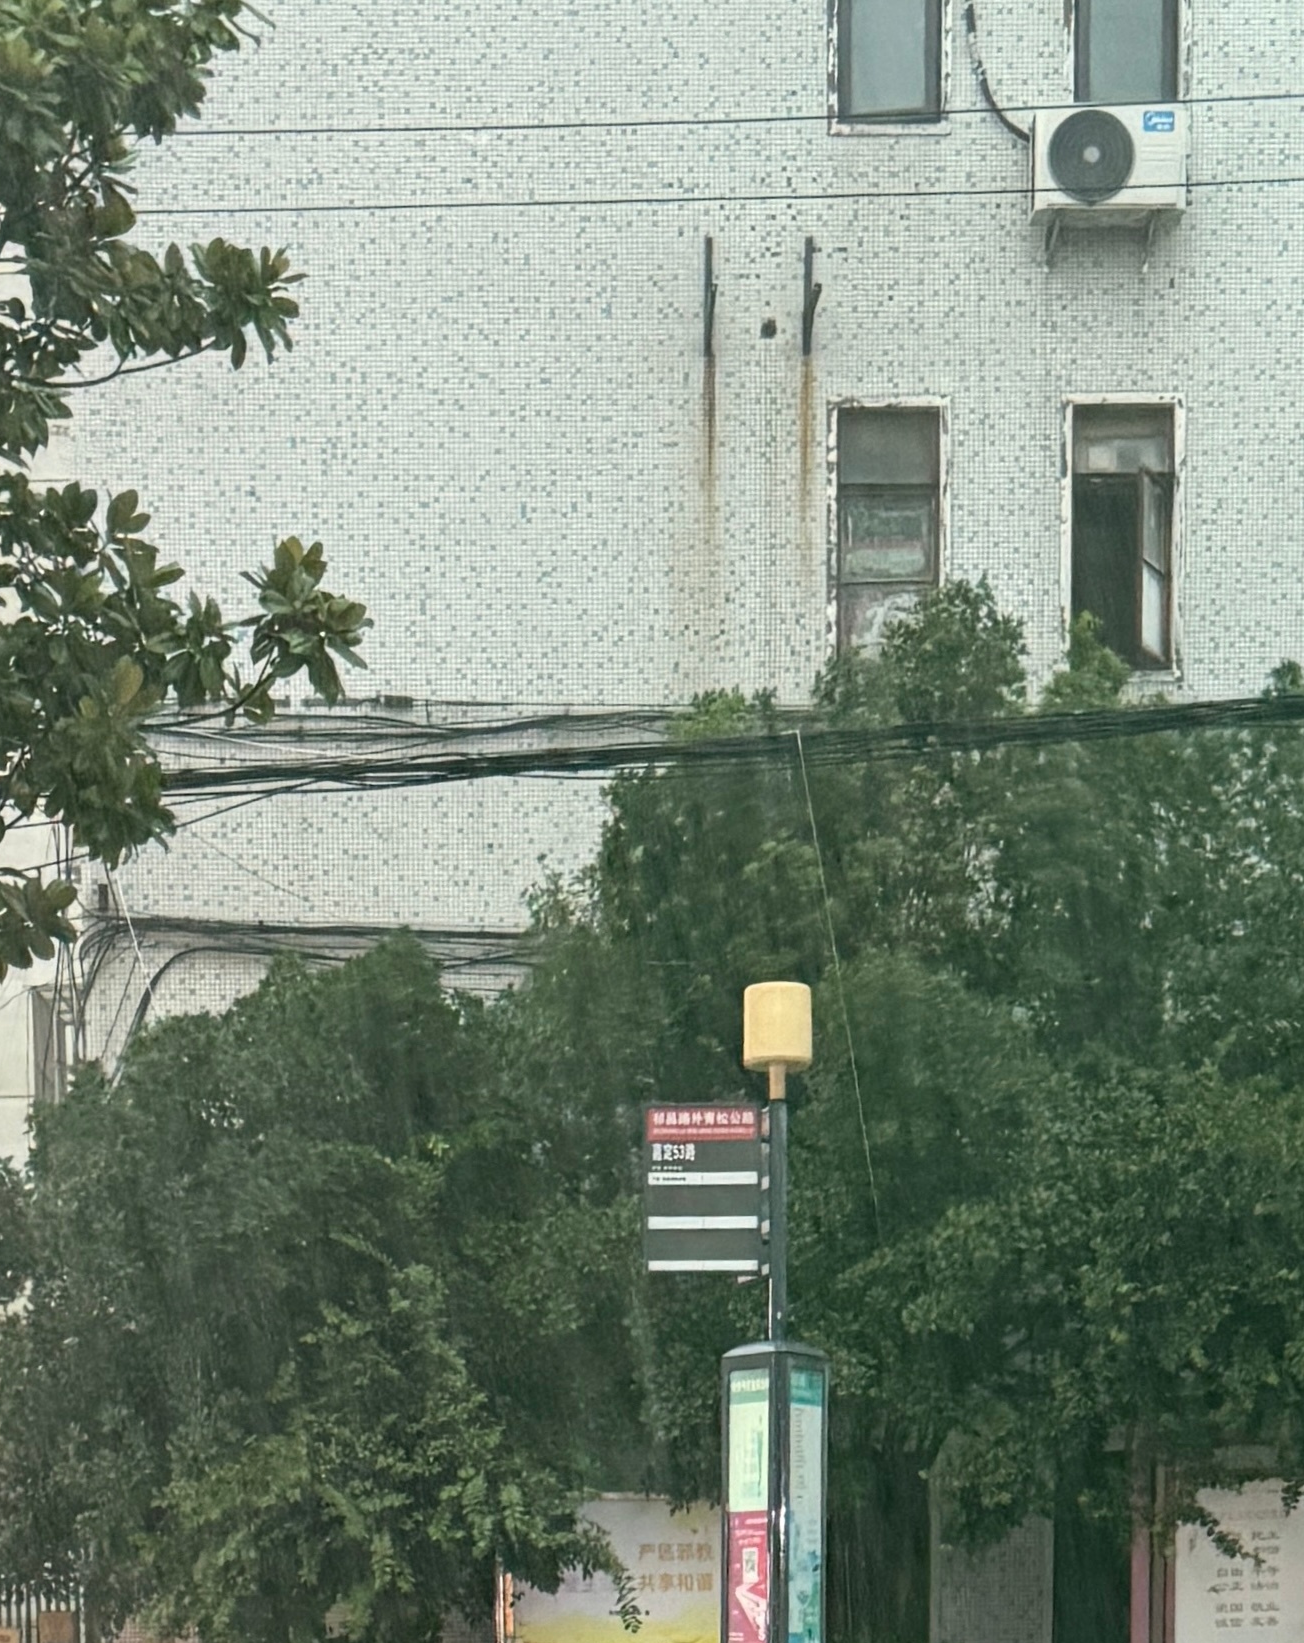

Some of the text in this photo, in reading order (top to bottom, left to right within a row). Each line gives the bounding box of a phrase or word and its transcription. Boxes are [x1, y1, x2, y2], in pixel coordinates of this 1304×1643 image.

[652, 1143, 695, 1161] 嘉定53路
[1216, 1567, 1244, 1578] 自由
[638, 1573, 713, 1592] 共享和谐
